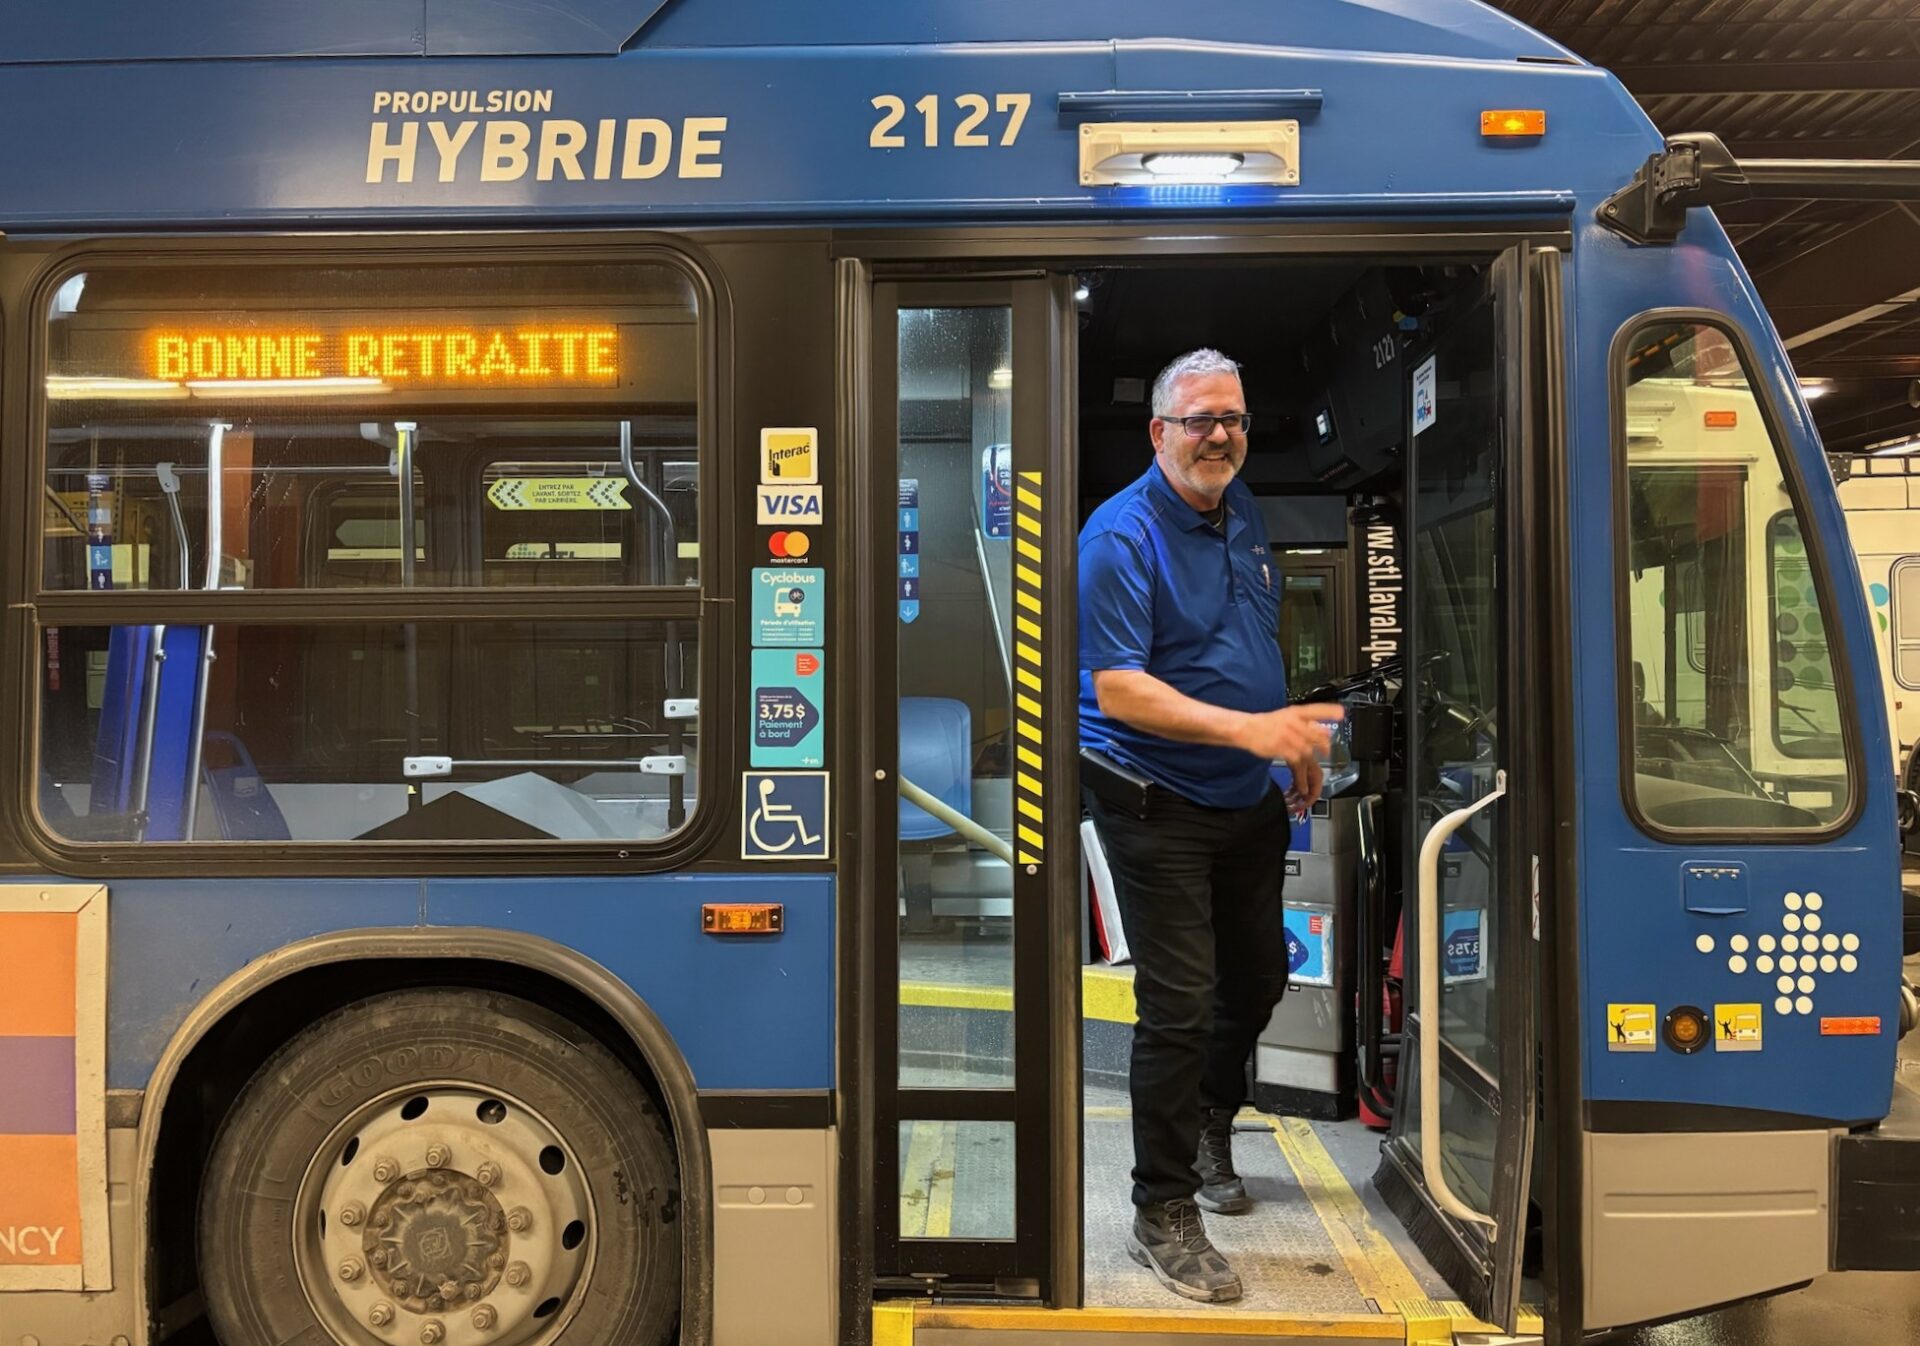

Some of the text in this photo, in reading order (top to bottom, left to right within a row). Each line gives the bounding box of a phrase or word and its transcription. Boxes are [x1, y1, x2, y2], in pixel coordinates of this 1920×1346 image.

[373, 89, 553, 114] PROPULSION
[869, 93, 1032, 148] 2127
[365, 117, 728, 183] HYBRIDE
[157, 331, 617, 379] BONNE RETRAITE
[760, 494, 821, 516] VISA
[760, 571, 816, 587] Cyclobus
[759, 719, 803, 729] Paiement
[767, 729, 791, 738] bord
